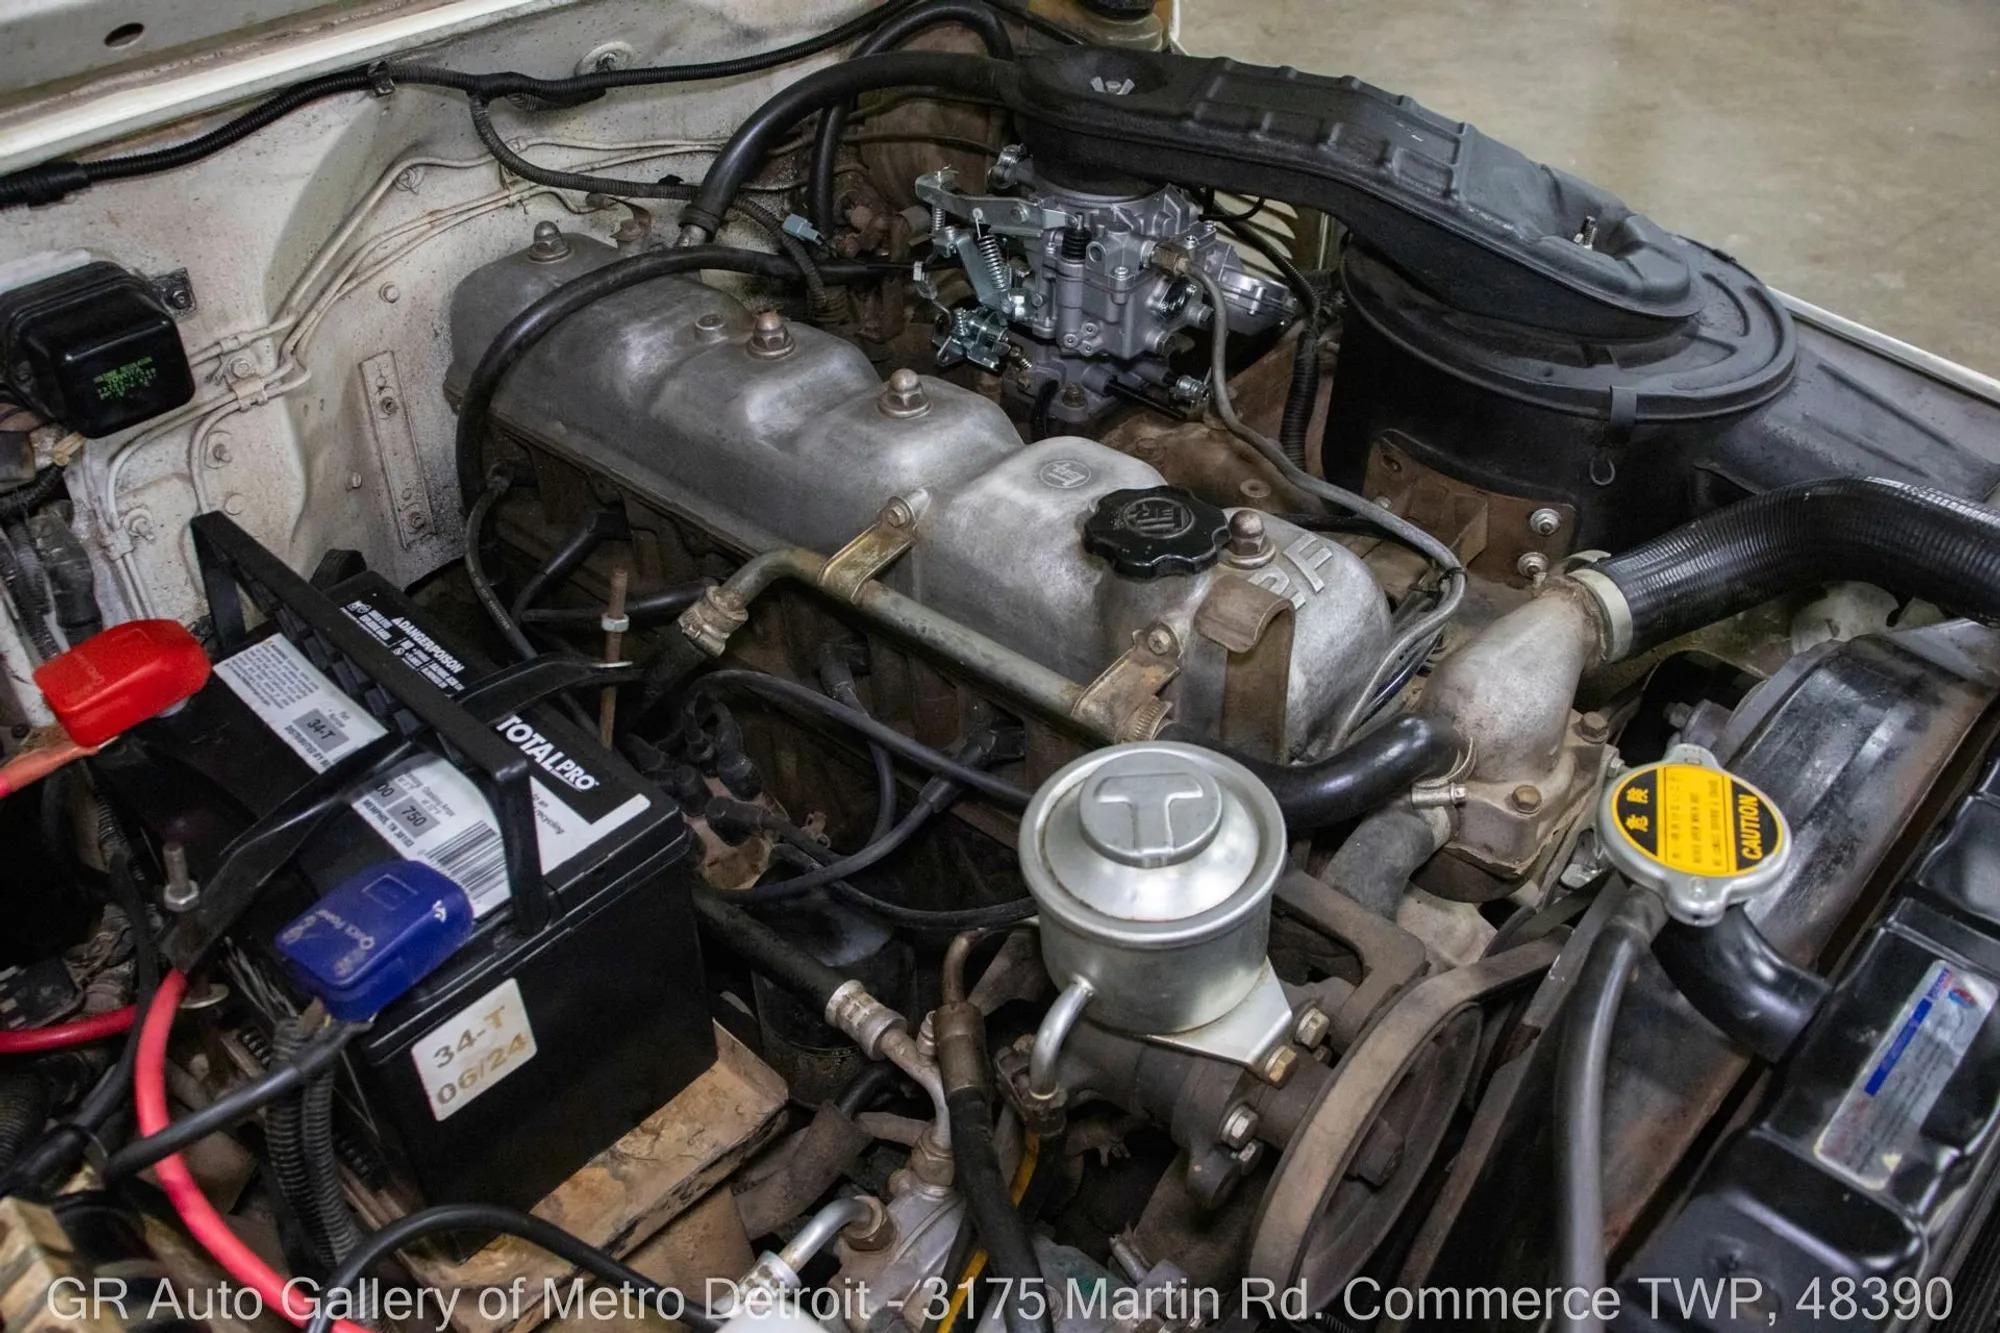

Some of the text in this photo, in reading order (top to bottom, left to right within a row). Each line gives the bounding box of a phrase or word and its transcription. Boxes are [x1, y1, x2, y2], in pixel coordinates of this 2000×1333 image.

[307, 718, 336, 740] 34-T
[401, 805, 427, 827] 750
[1738, 794, 1763, 860] CAUTION
[434, 1005, 505, 1069] 34-T
[437, 1032, 528, 1105] 06/24
